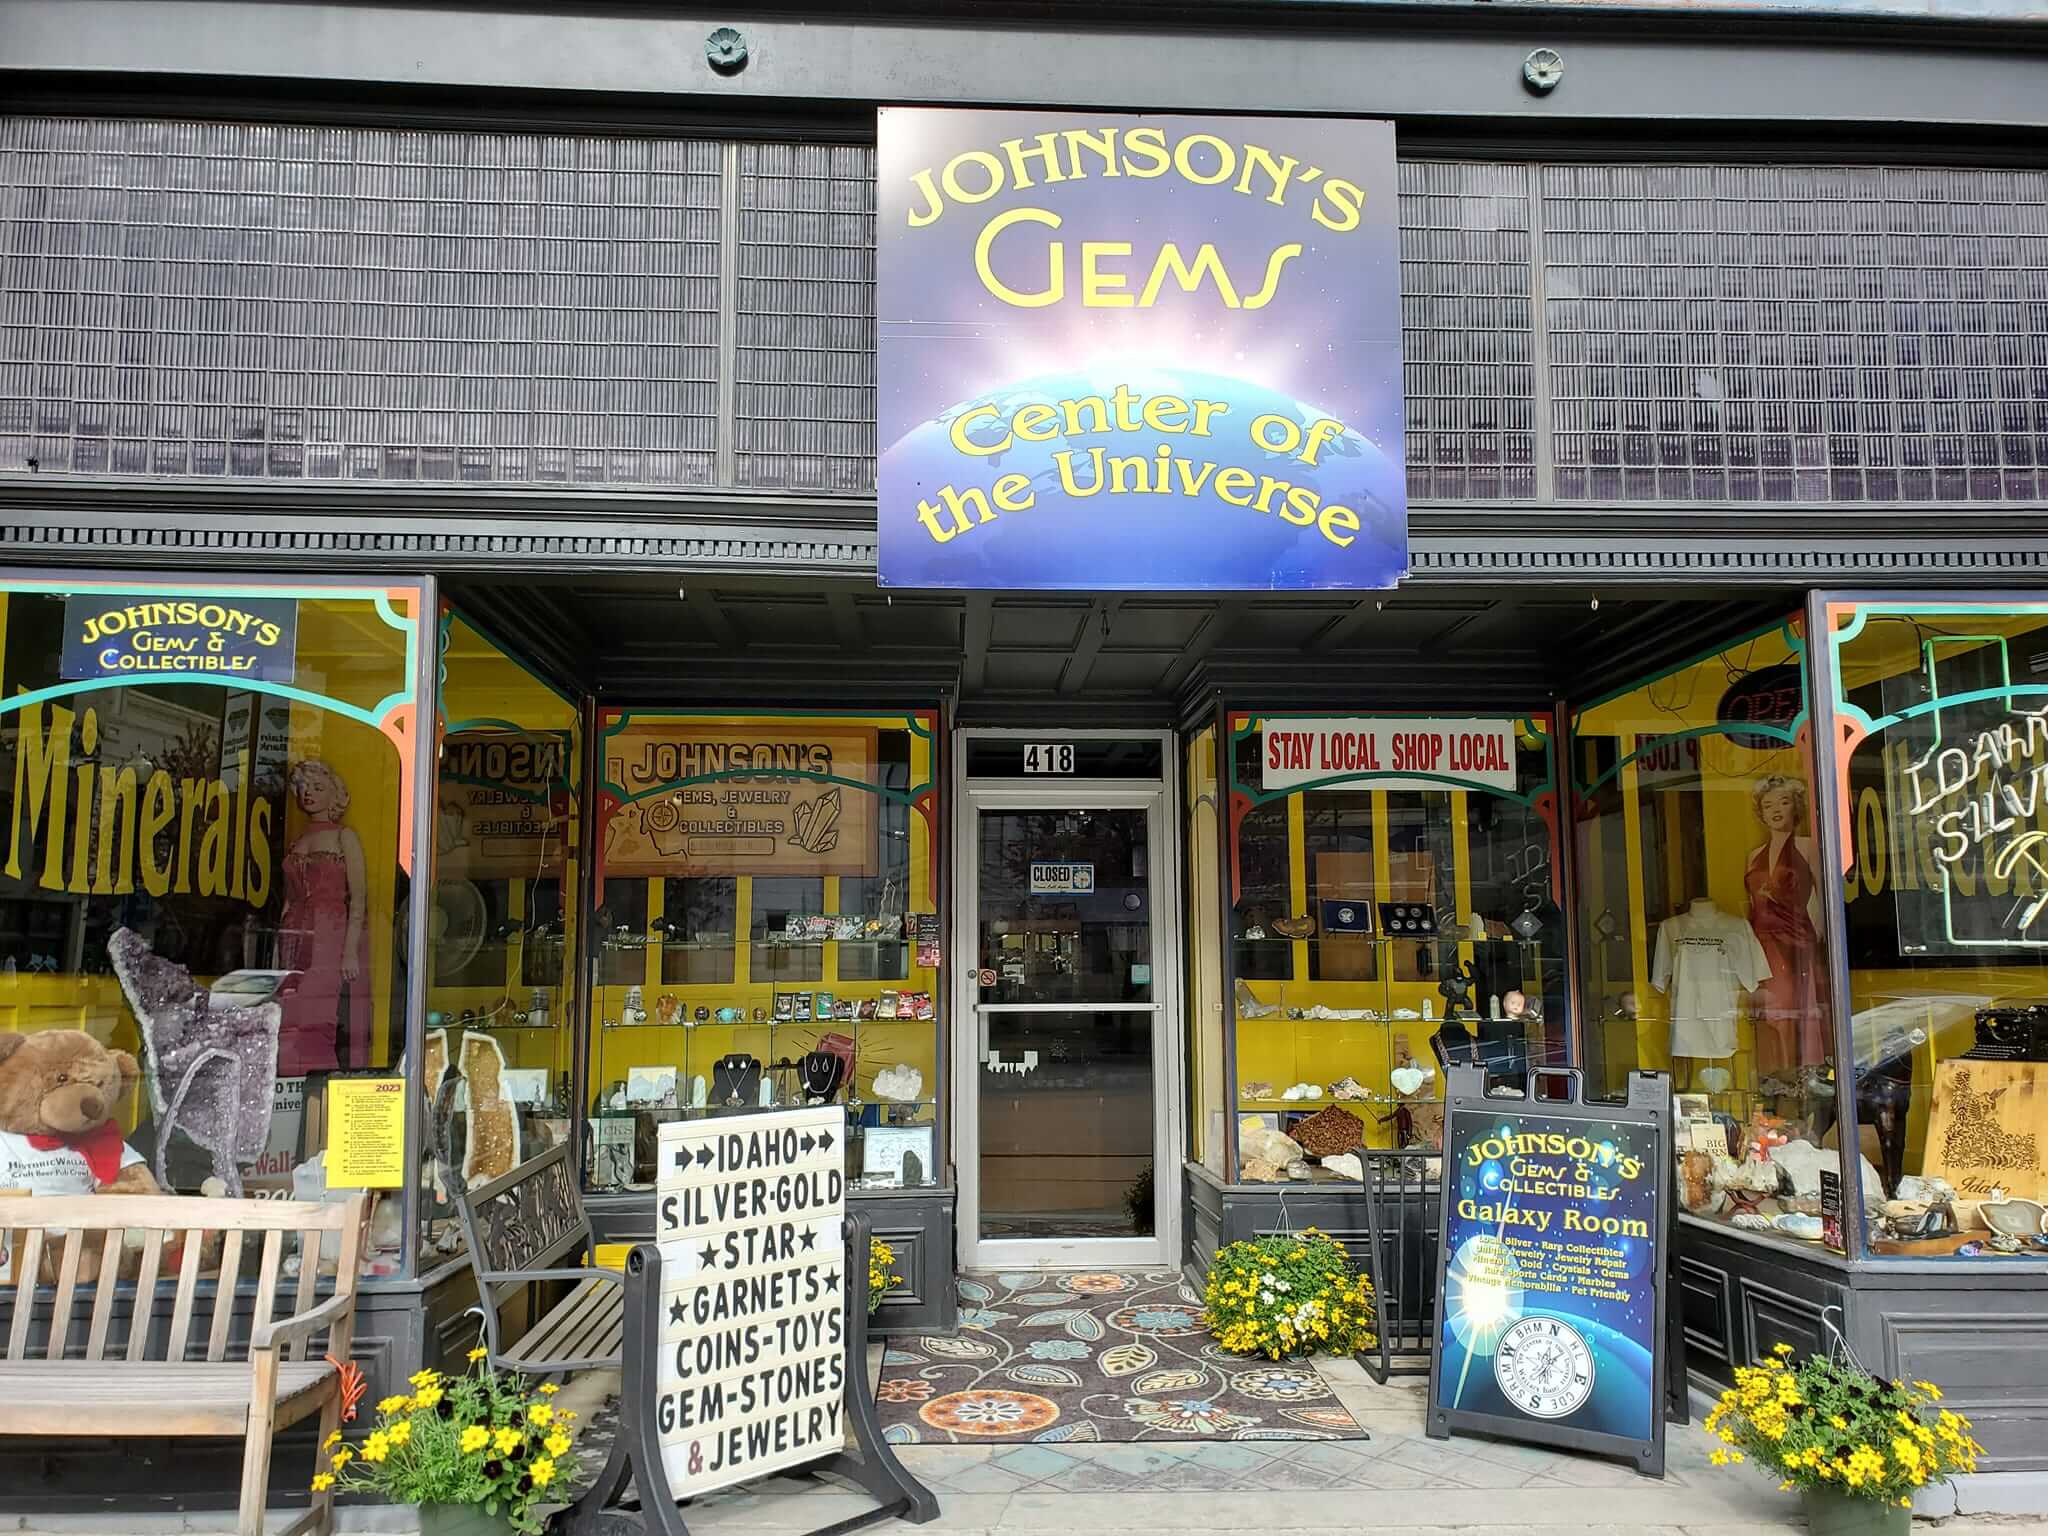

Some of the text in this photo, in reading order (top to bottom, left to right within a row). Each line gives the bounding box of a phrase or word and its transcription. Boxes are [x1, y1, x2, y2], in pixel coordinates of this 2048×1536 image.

[907, 127, 1366, 233] JOHNSON'S
[974, 207, 1303, 309] GEMS
[950, 384, 1345, 467] Center of
[917, 444, 1361, 548] the Universe
[82, 603, 281, 646] JOHNSON'S
[132, 631, 225, 652] GEMS &
[99, 649, 257, 670] COLLECTIBLES
[631, 743, 832, 783] JOHNSON'S
[1026, 745, 1072, 771] 418
[1268, 732, 1509, 771] STAY LOCAL SHOP LOCAL
[3, 684, 271, 909] Minerals
[674, 791, 790, 806] GEMS, JEWELRY
[680, 821, 784, 834] COLLECTIBLES
[1034, 867, 1070, 881] CLOSED
[718, 1127, 798, 1172] IDAHO
[1468, 1133, 1641, 1179] JOHNSON'S
[1483, 1172, 1620, 1201] COLLECTIBLES
[1510, 1158, 1591, 1182] GEMS &
[1458, 1199, 1648, 1238] Galaxy Room
[723, 1222, 795, 1270] STAR
[1505, 1237, 1533, 1248] Silver
[1542, 1241, 1564, 1251] Rare
[1567, 1243, 1624, 1258] Collectibles
[1511, 1248, 1546, 1260] Jewelry
[1555, 1252, 1592, 1266] Jewelry
[1595, 1258, 1627, 1270] Repair
[1508, 1267, 1537, 1279] Sports
[1540, 1271, 1568, 1283] Cards
[1577, 1277, 1616, 1289] Marbles
[1520, 1260, 1543, 1270] Gold
[1552, 1263, 1591, 1275] Crystals
[1601, 1269, 1629, 1280] Gems
[693, 1265, 819, 1325] GARNETS
[1503, 1279, 1562, 1293] Memorabilia
[1571, 1286, 1588, 1296] Pet
[1590, 1288, 1631, 1303] Friendly
[676, 1307, 841, 1379] COINS-TOYS
[1515, 1322, 1561, 1339] BHM N
[658, 1353, 843, 1435] GEM-STONES
[687, 1400, 840, 1475] & JEWELRY
